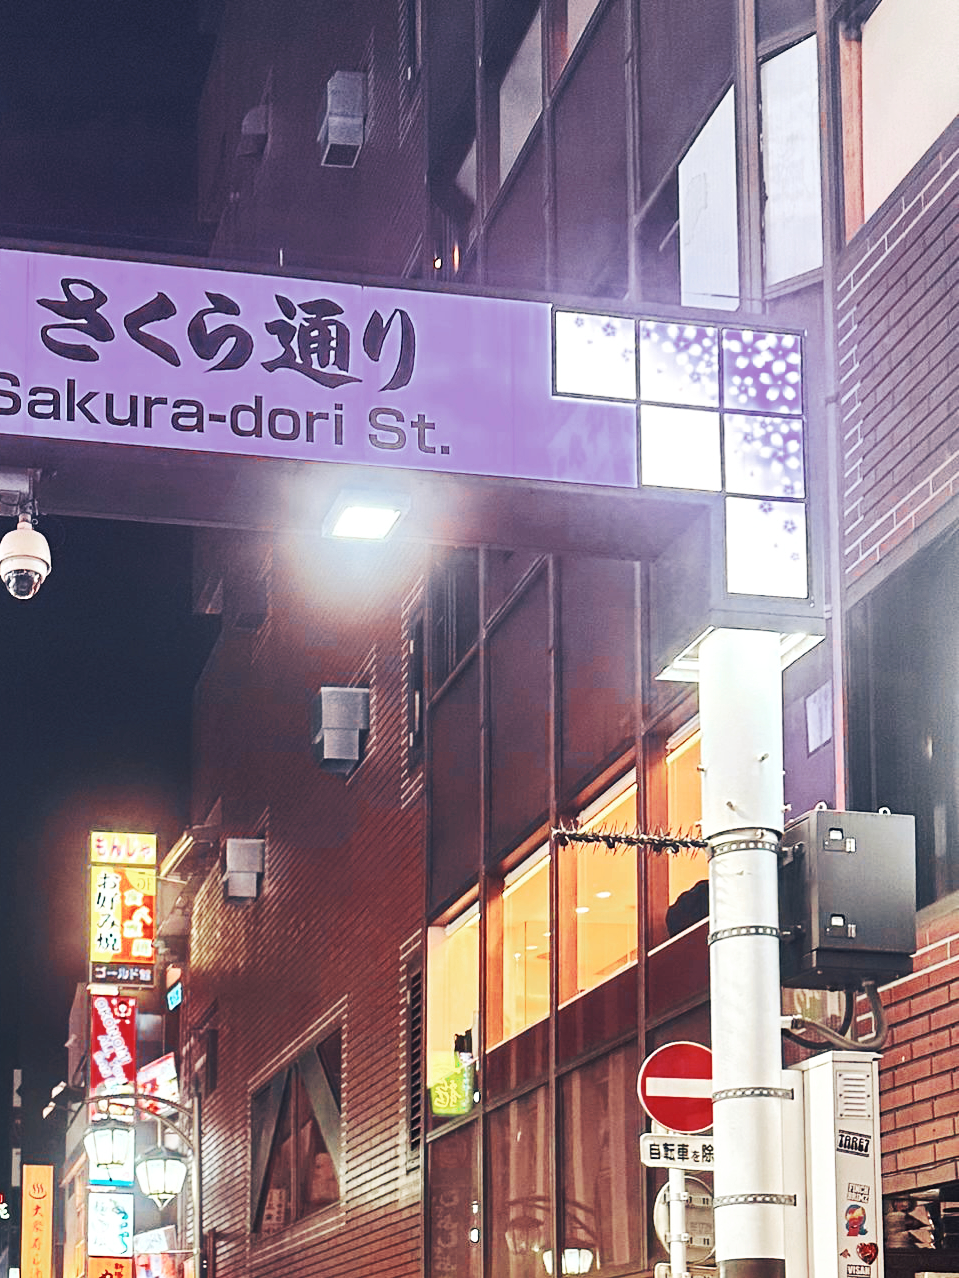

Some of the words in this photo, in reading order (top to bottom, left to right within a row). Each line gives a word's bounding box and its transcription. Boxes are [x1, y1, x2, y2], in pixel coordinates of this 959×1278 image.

[36, 277, 416, 392] さくら通り
[368, 406, 451, 455] St.
